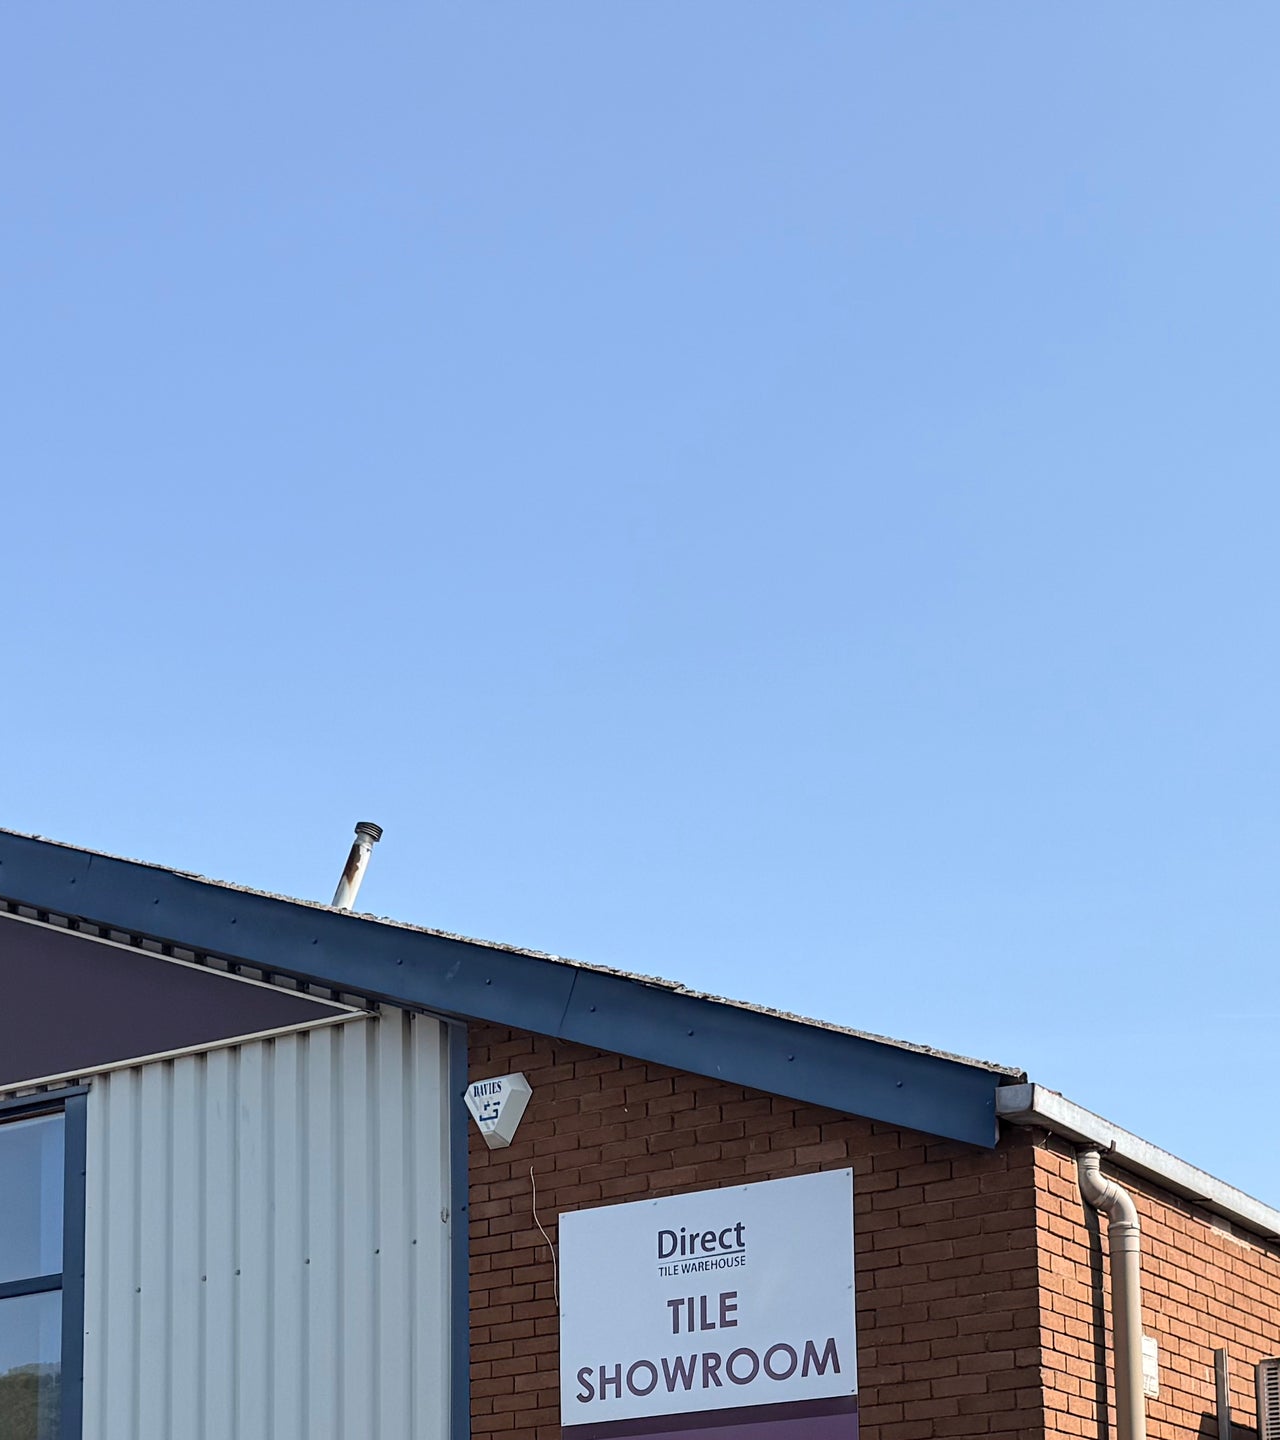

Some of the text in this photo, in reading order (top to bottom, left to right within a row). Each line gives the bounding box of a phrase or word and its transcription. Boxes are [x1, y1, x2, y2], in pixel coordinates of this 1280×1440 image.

[473, 1080, 502, 1097] DAVIES
[657, 1222, 746, 1259] Direct
[658, 1255, 747, 1277] TILE WAREHOUSE
[667, 1291, 739, 1334] TILE
[576, 1338, 841, 1403] SHOWROOM
